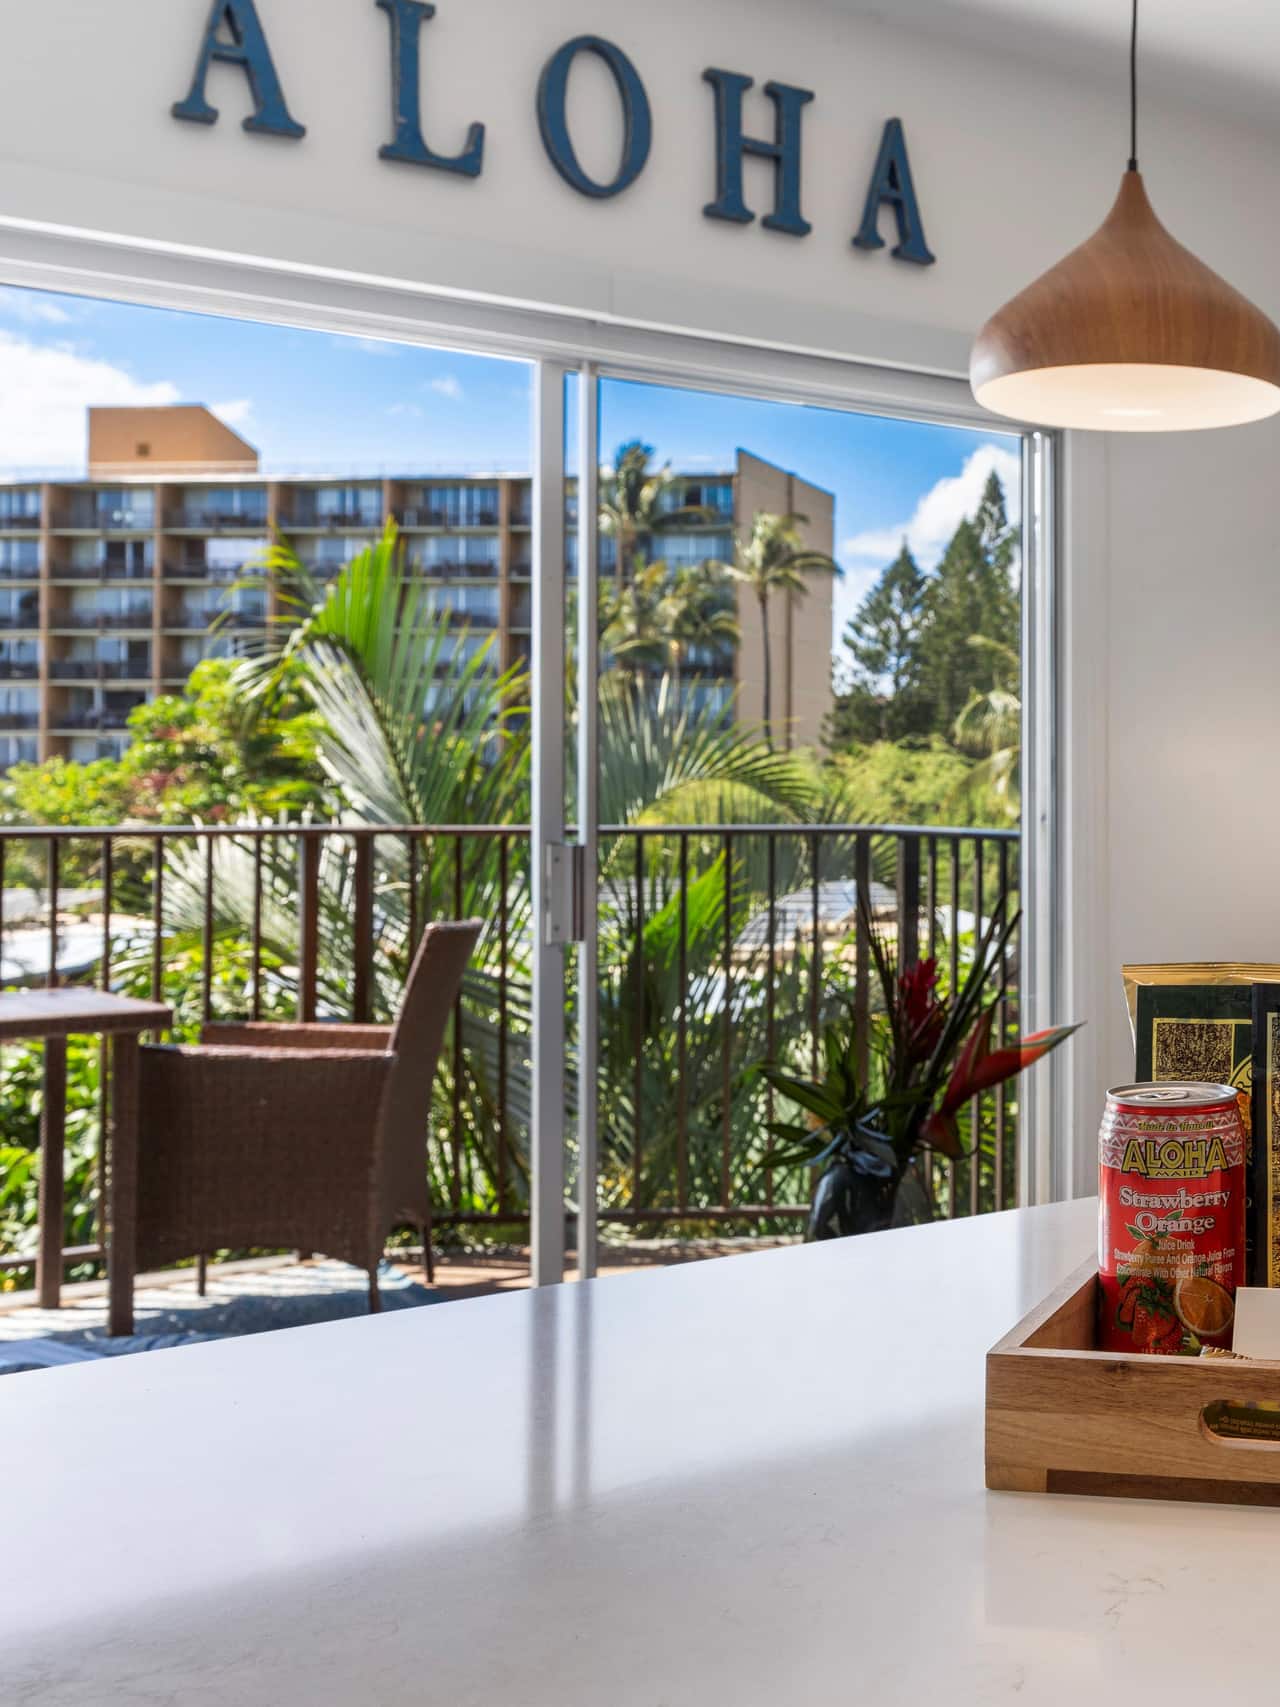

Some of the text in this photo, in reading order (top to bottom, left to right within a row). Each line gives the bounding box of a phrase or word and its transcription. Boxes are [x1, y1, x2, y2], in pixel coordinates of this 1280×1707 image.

[171, 0, 936, 266] ALOHA
[1121, 1136, 1230, 1175] ALOHA
[1119, 1185, 1231, 1209] Strawberry
[1135, 1211, 1216, 1235] Orange
[1158, 1239, 1196, 1250] Juice Drink
[1167, 1254, 1180, 1264] And
[1182, 1252, 1206, 1265] Orange
[1207, 1250, 1222, 1263] Juice
[1215, 1261, 1232, 1274] Flavors
